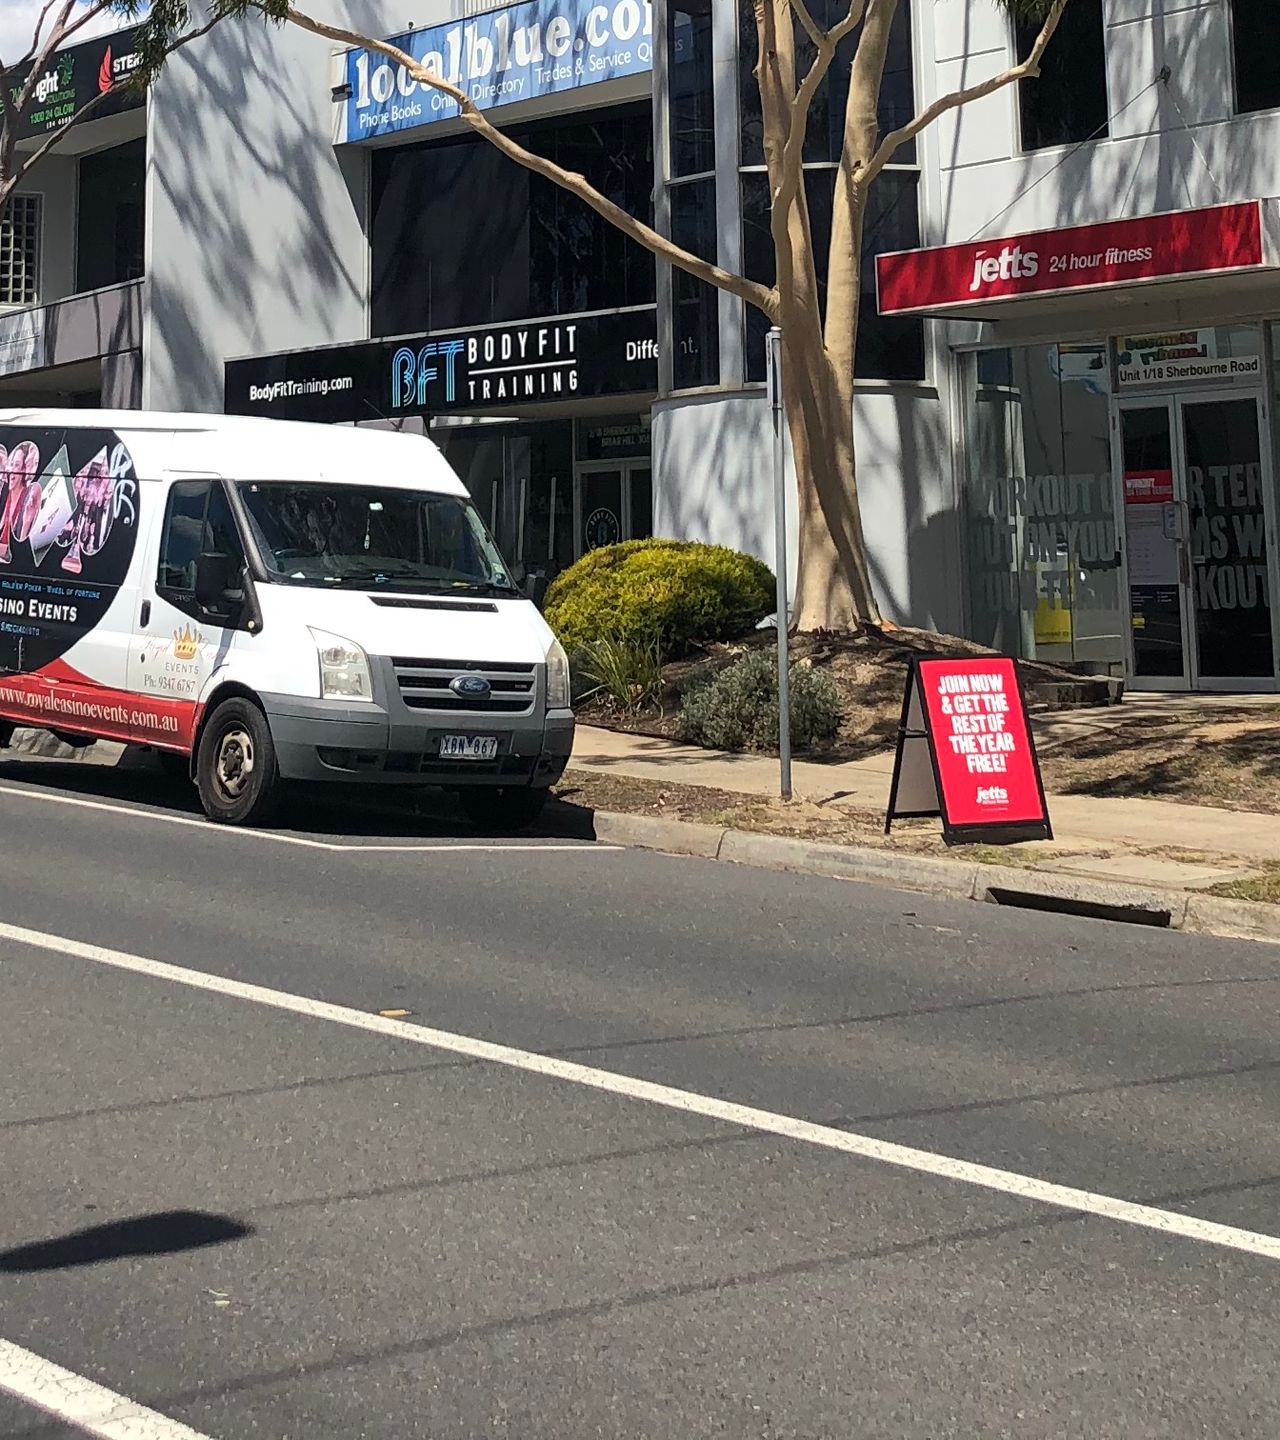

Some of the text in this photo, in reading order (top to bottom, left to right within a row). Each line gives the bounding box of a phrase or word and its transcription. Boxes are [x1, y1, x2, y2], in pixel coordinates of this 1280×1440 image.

[360, 108, 389, 129] Phone
[391, 103, 421, 123] Books
[472, 77, 524, 101] Directory
[535, 62, 572, 84] Trades
[575, 58, 584, 74] &
[589, 51, 632, 72] Service
[970, 245, 1152, 292] jetts 24 hour fitness
[392, 338, 465, 408] BFT
[468, 331, 528, 363] BODY
[538, 325, 578, 356] FIT
[1120, 360, 1258, 382] Unit 1/18 Sherbourne Road
[249, 369, 579, 402] BodyFitTraining.com TRAINING
[28, 599, 78, 623] EVENTS
[165, 662, 199, 675] EVENTS
[144, 673, 196, 693] Ph: 9347 6787
[937, 673, 1003, 695] JOIN NOW
[941, 693, 1009, 714] & GET THE
[951, 713, 1006, 734] REST OF
[948, 732, 1015, 754] THE YEAR
[976, 786, 1008, 804] jetts
